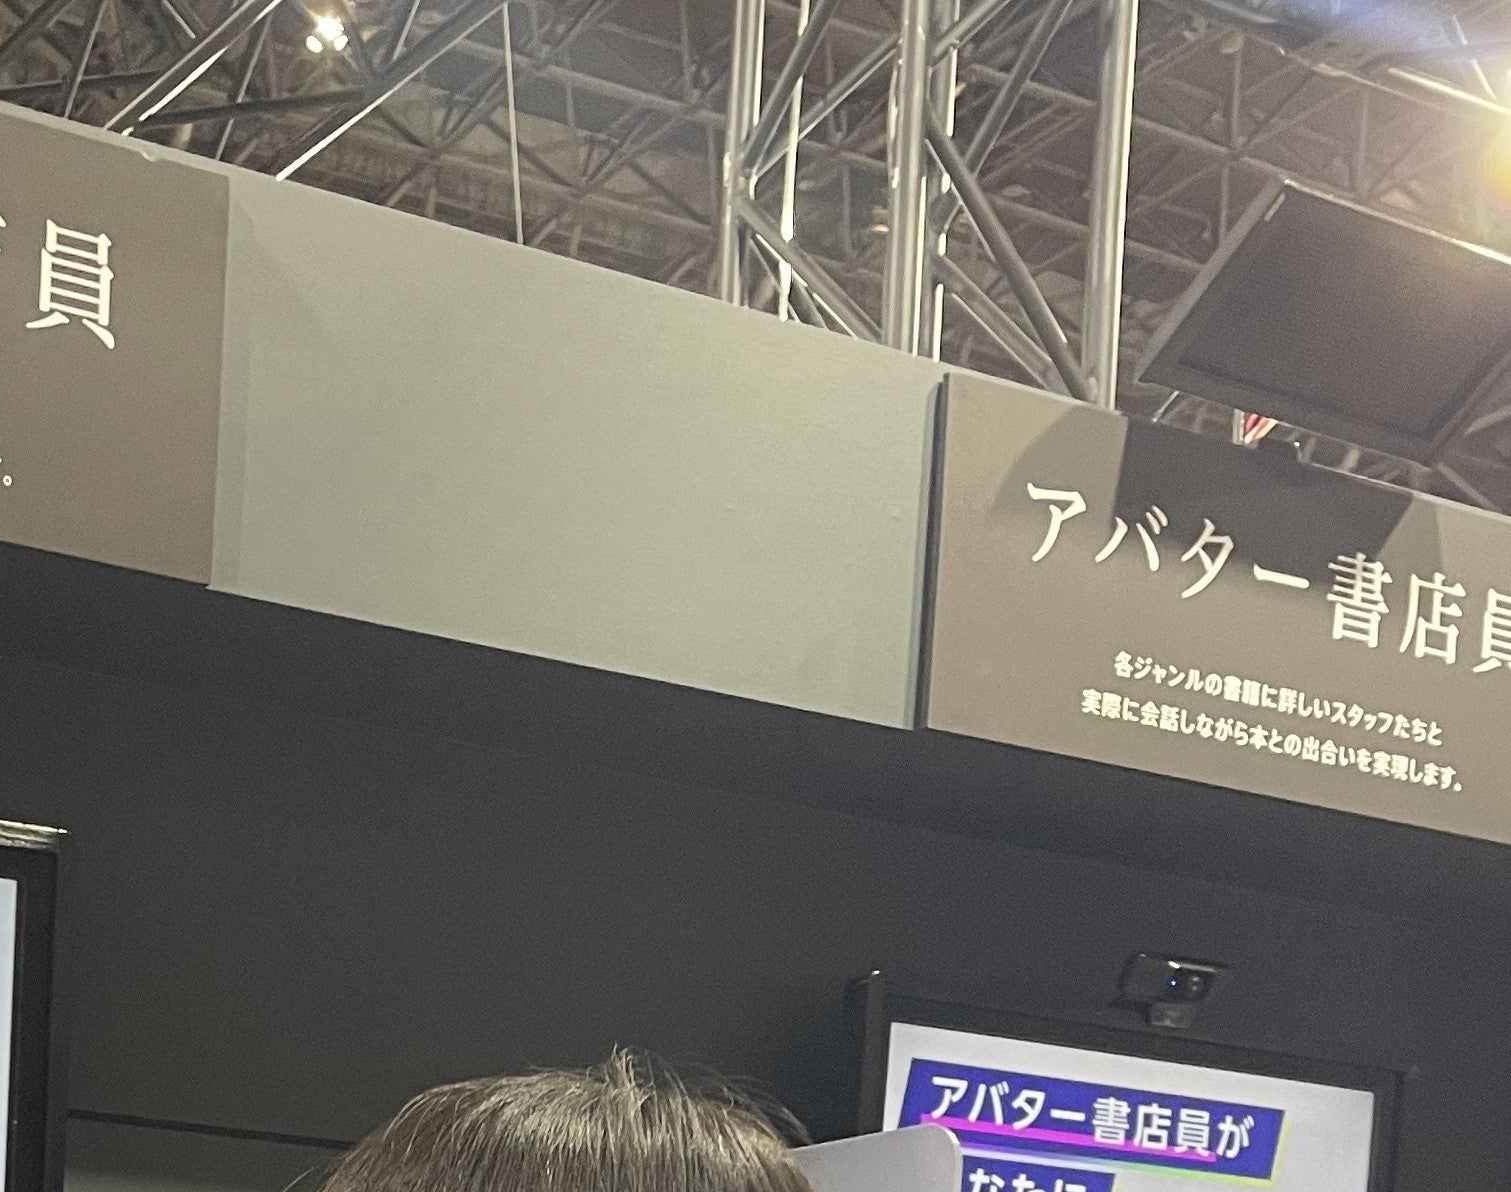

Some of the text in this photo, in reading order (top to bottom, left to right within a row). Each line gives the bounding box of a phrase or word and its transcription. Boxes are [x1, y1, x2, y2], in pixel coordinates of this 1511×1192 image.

[1026, 482, 1511, 674] アバター書店員
[1081, 688, 1463, 792] 実際に会話しながら本との出合いを実現します。
[1114, 650, 1444, 746] 各ジャンルの書籍に詳しいスタッフたちと
[931, 1076, 1254, 1159] アバター書店員が
